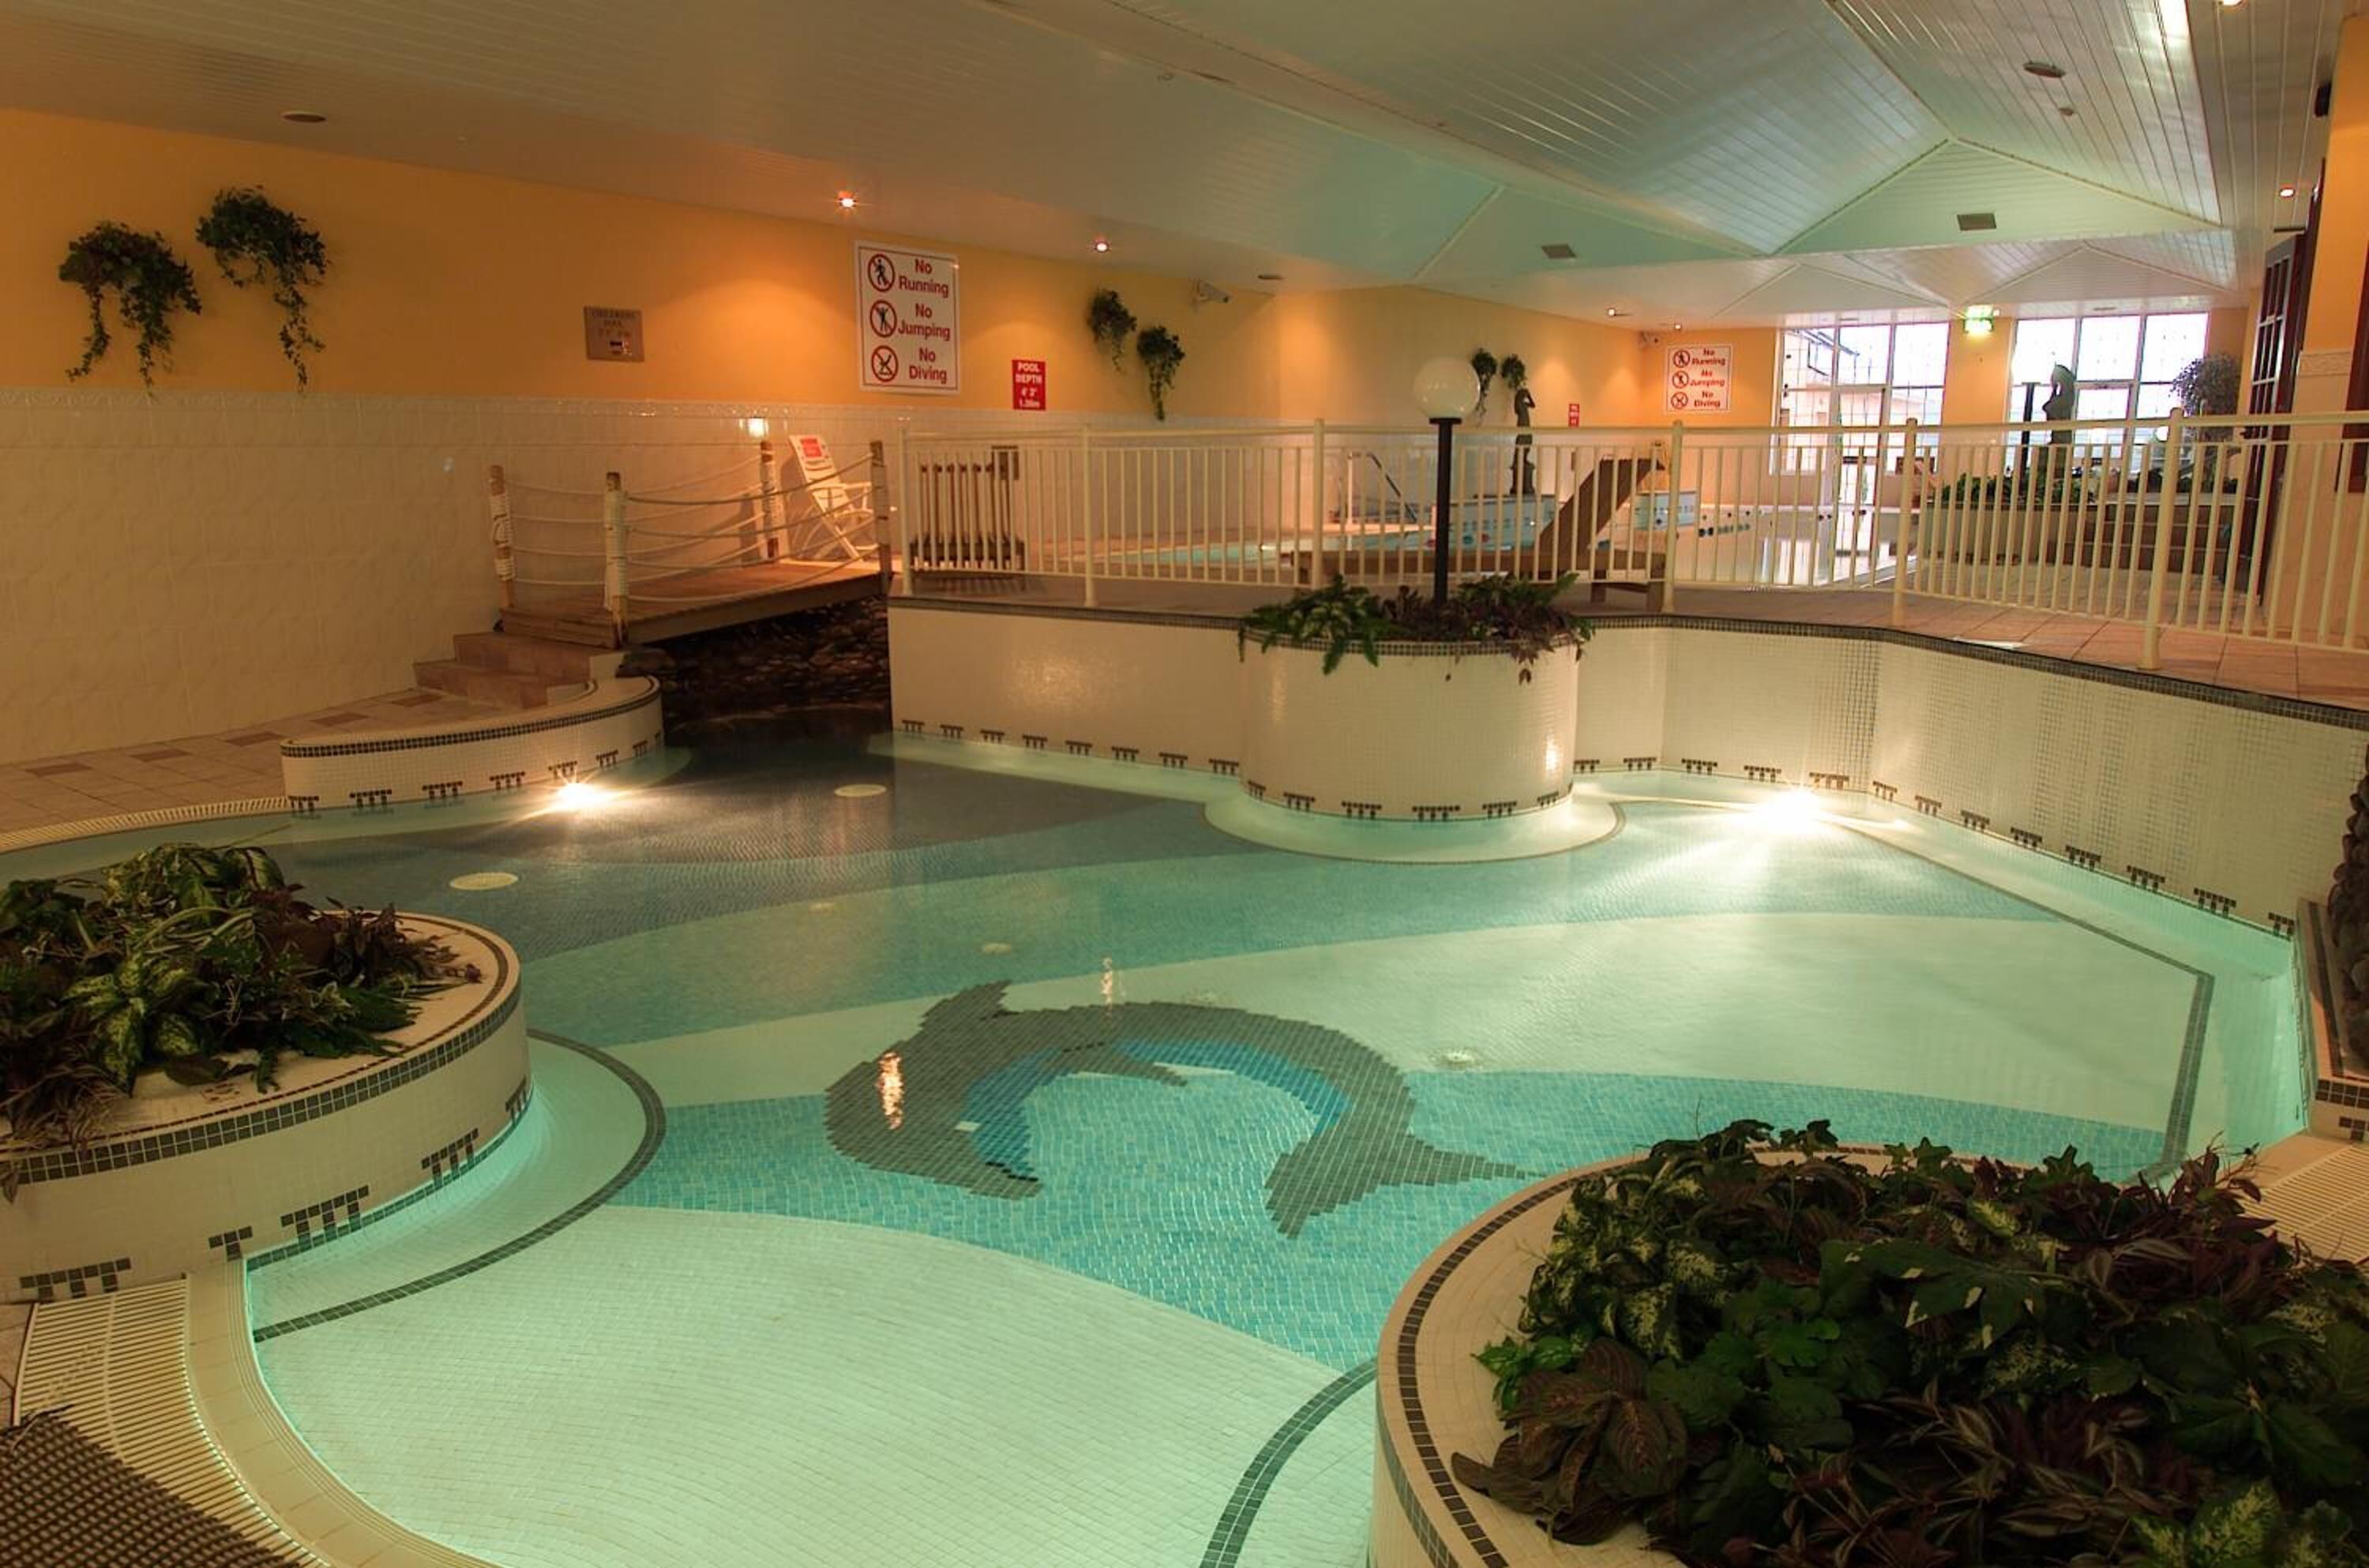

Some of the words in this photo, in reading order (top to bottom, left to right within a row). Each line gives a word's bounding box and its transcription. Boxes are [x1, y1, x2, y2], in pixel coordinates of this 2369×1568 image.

[914, 258, 933, 275] No
[898, 276, 949, 298] Running
[914, 303, 933, 318] No
[898, 321, 951, 341] Jumping
[918, 347, 936, 362] No
[1691, 358, 1725, 366] Running
[909, 366, 947, 384] Diving
[1017, 362, 1040, 373] POOL
[1015, 373, 1042, 384] DEPTH
